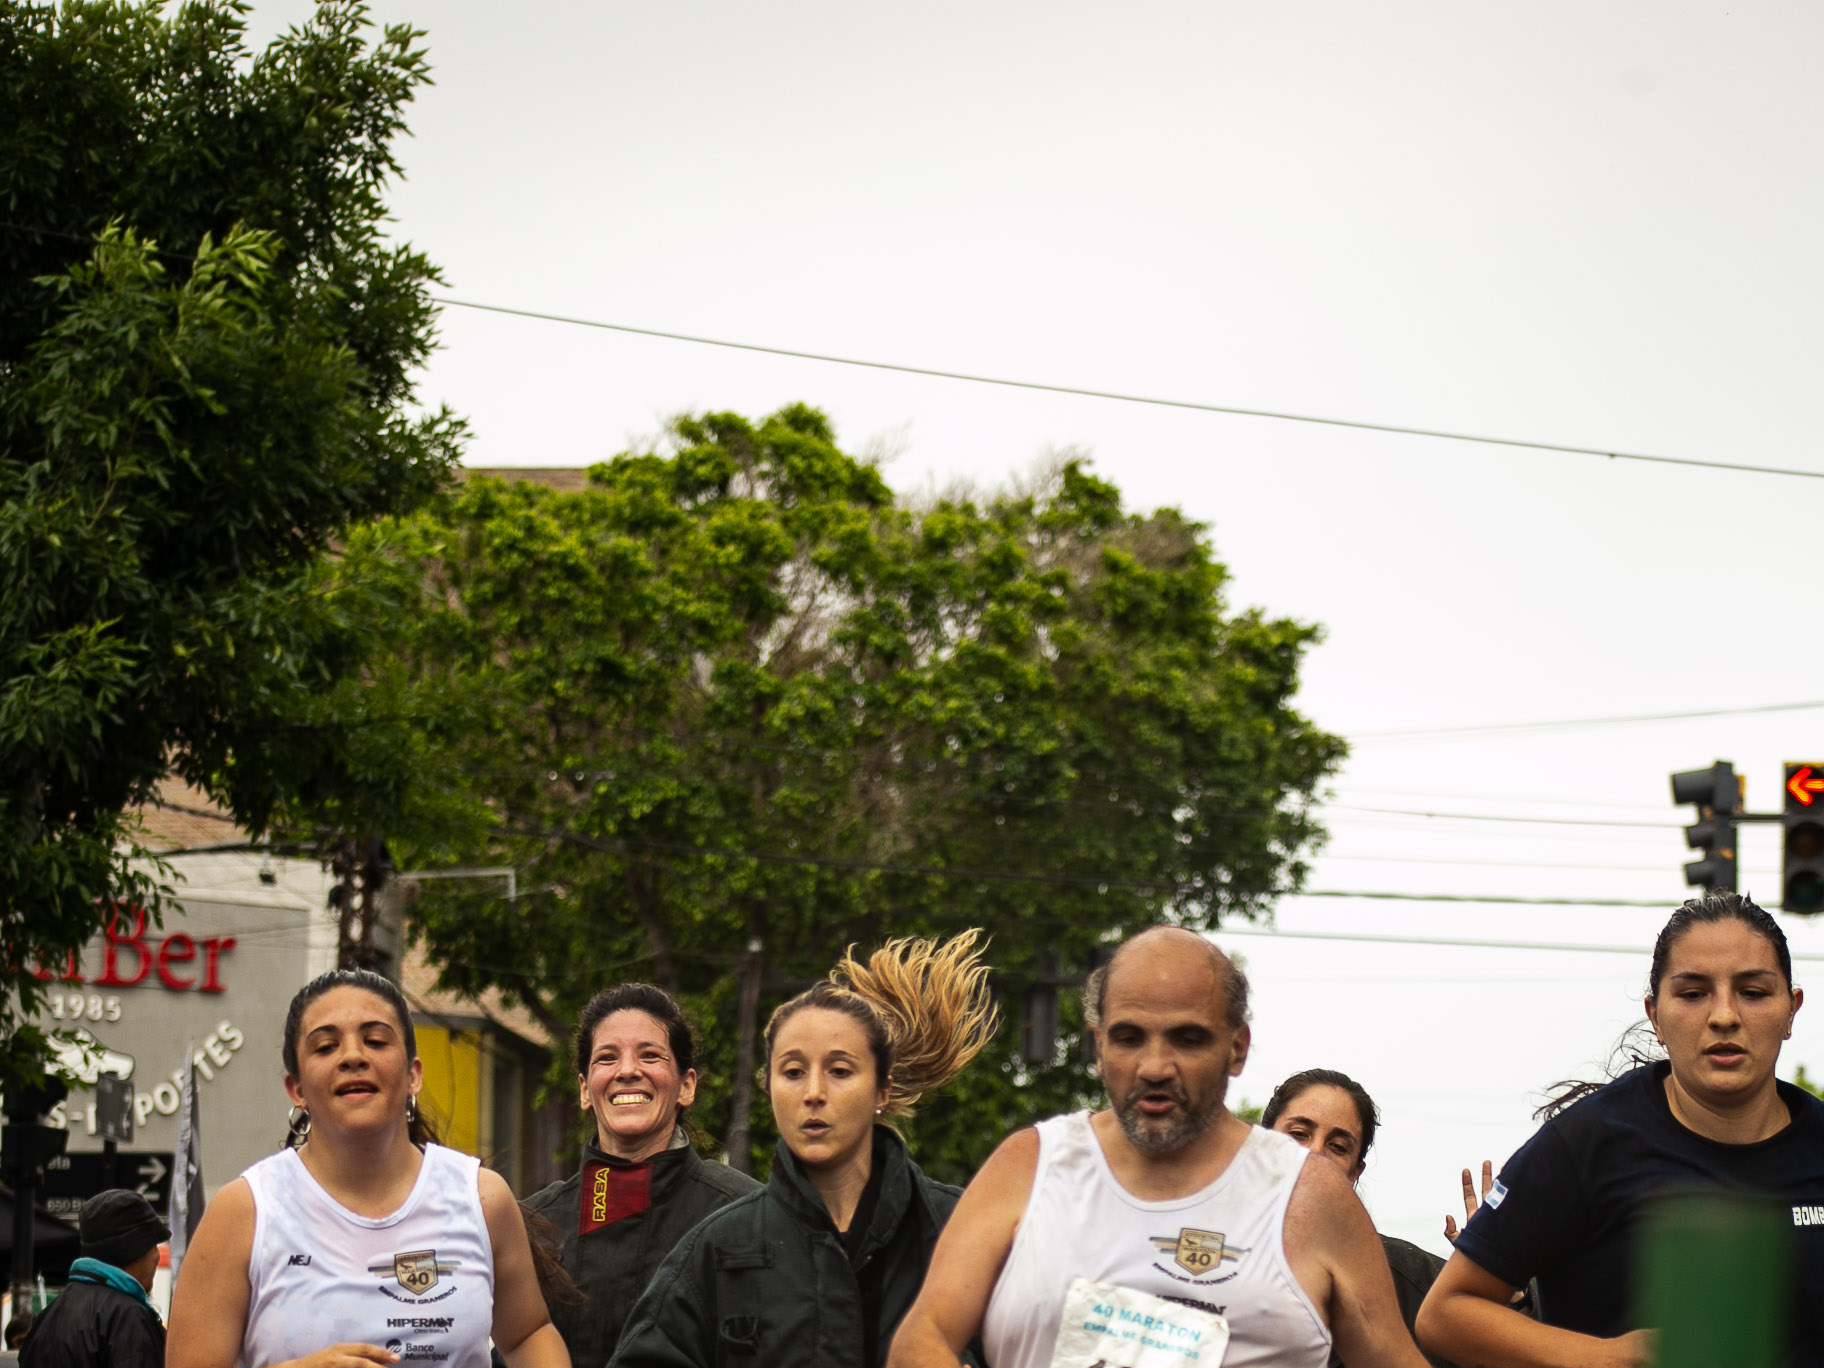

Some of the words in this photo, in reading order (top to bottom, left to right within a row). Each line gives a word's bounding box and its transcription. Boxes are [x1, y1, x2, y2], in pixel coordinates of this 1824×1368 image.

[52, 994, 121, 1022] 1985
[592, 1167, 610, 1222] RASA
[287, 1254, 312, 1267] NEJ
[1185, 1252, 1212, 1266] 40
[406, 1272, 430, 1286] 40
[378, 1285, 416, 1305] EMPALME
[1093, 1303, 1114, 1318] 40
[1119, 1308, 1202, 1342] MARATON
[405, 1342, 434, 1352] Banco
[404, 1352, 449, 1362] Municipal
